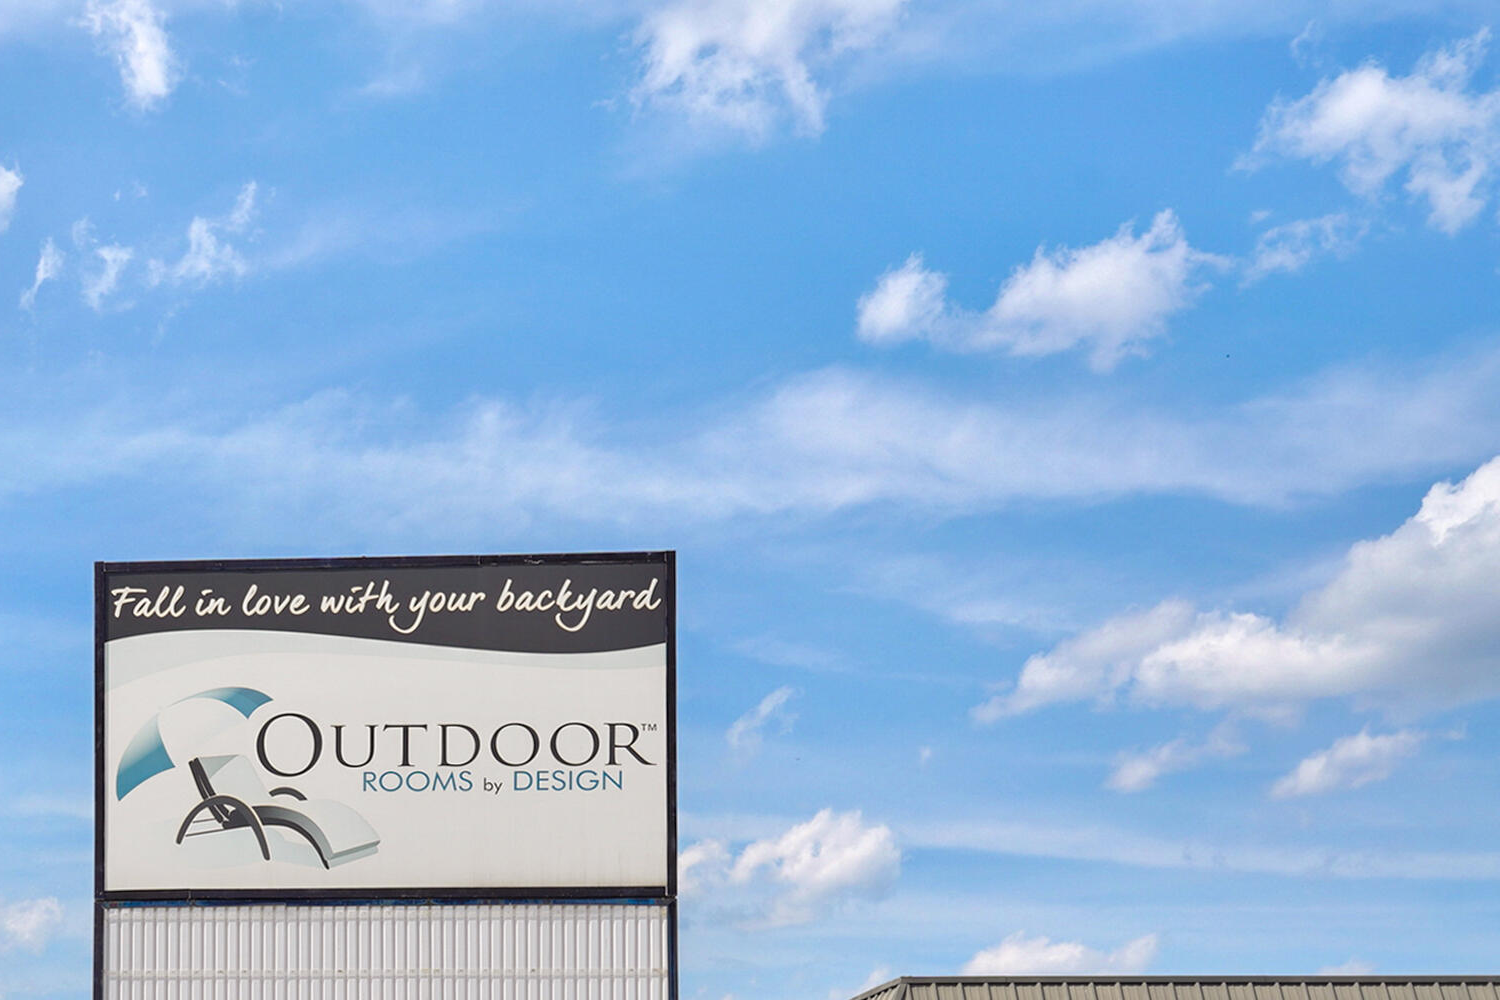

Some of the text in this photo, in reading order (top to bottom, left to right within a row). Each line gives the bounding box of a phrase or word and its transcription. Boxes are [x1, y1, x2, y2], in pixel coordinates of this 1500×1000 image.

[111, 579, 662, 634] Fall in love with your backyard
[255, 712, 658, 778] OUTDOOR
[362, 768, 624, 795] ROOMS by DESIGN
